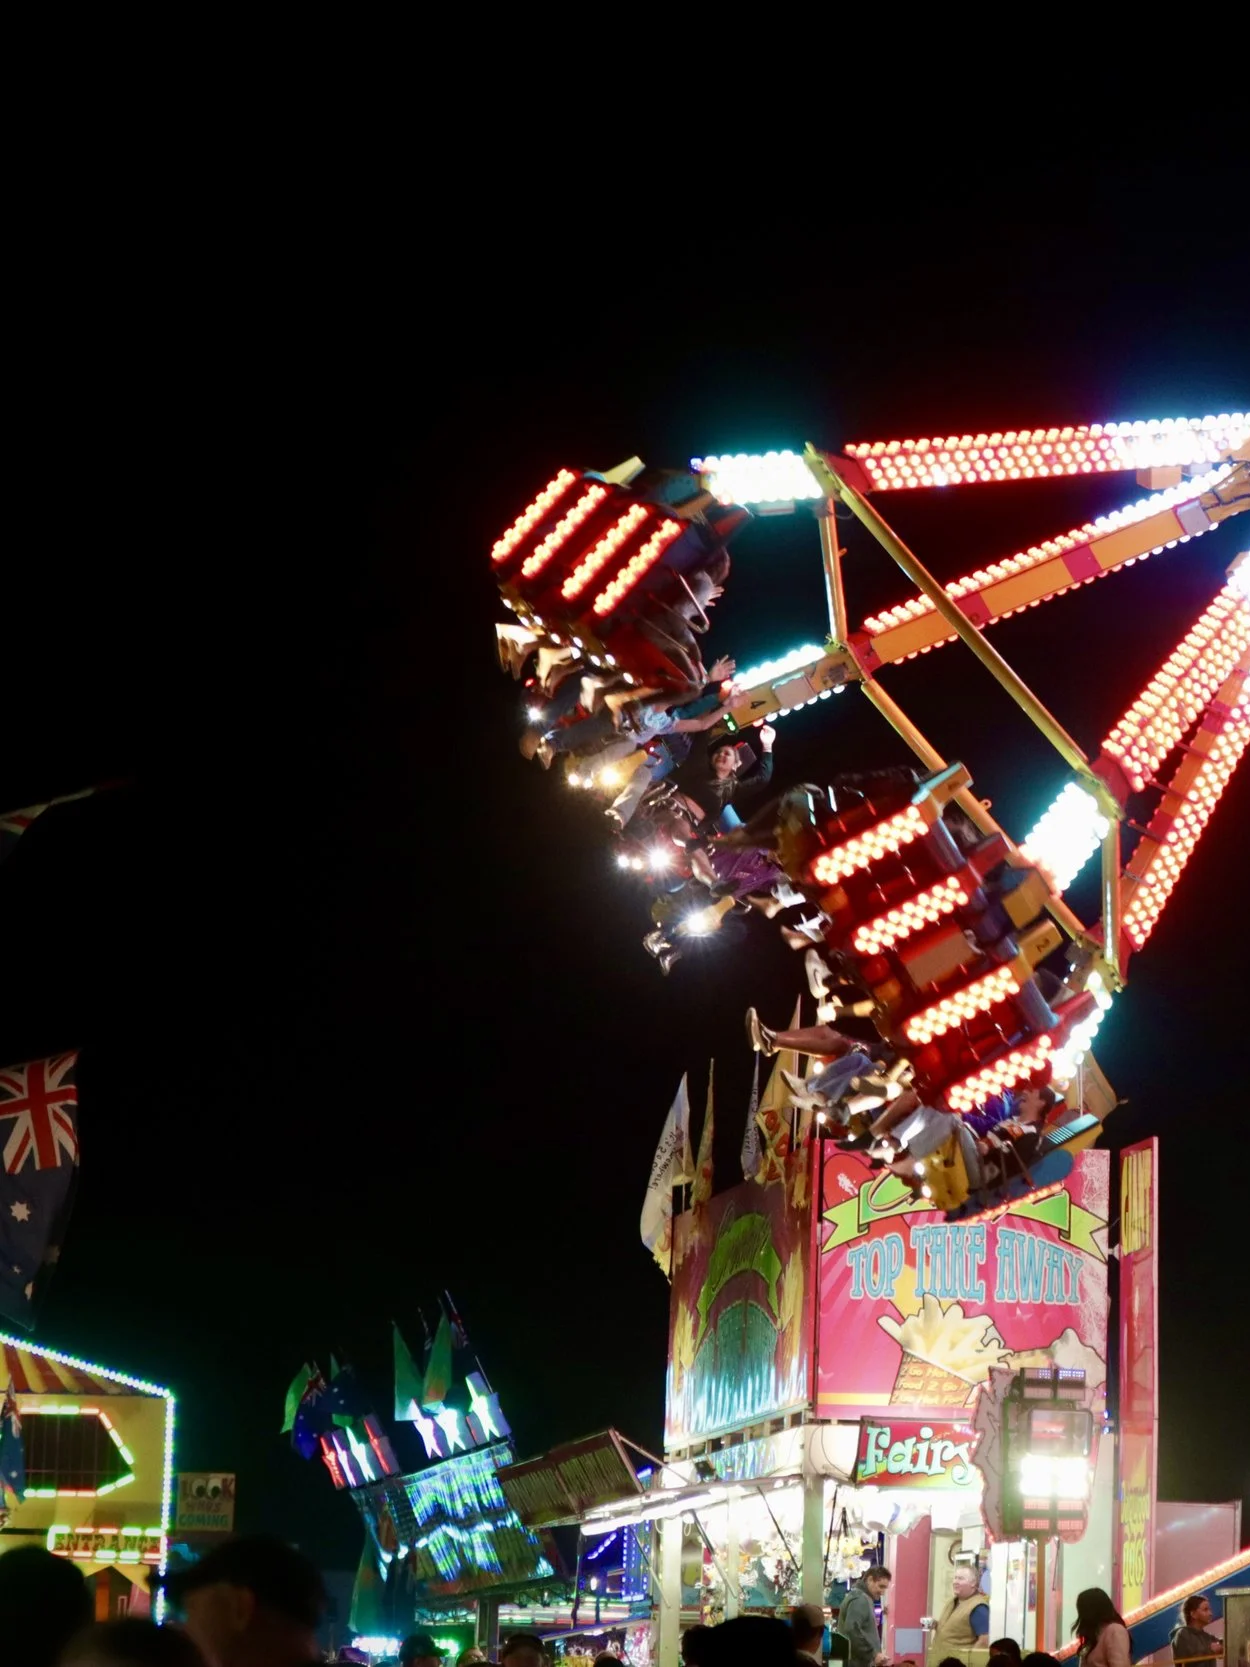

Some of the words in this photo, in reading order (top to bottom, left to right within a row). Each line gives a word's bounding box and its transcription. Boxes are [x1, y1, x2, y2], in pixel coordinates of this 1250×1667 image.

[848, 1232, 905, 1299] TOP
[911, 1222, 988, 1303] TAKE
[996, 1227, 1085, 1304] AWAY
[863, 1426, 976, 1485] Fairy
[54, 1533, 161, 1550] ENTRANCE
